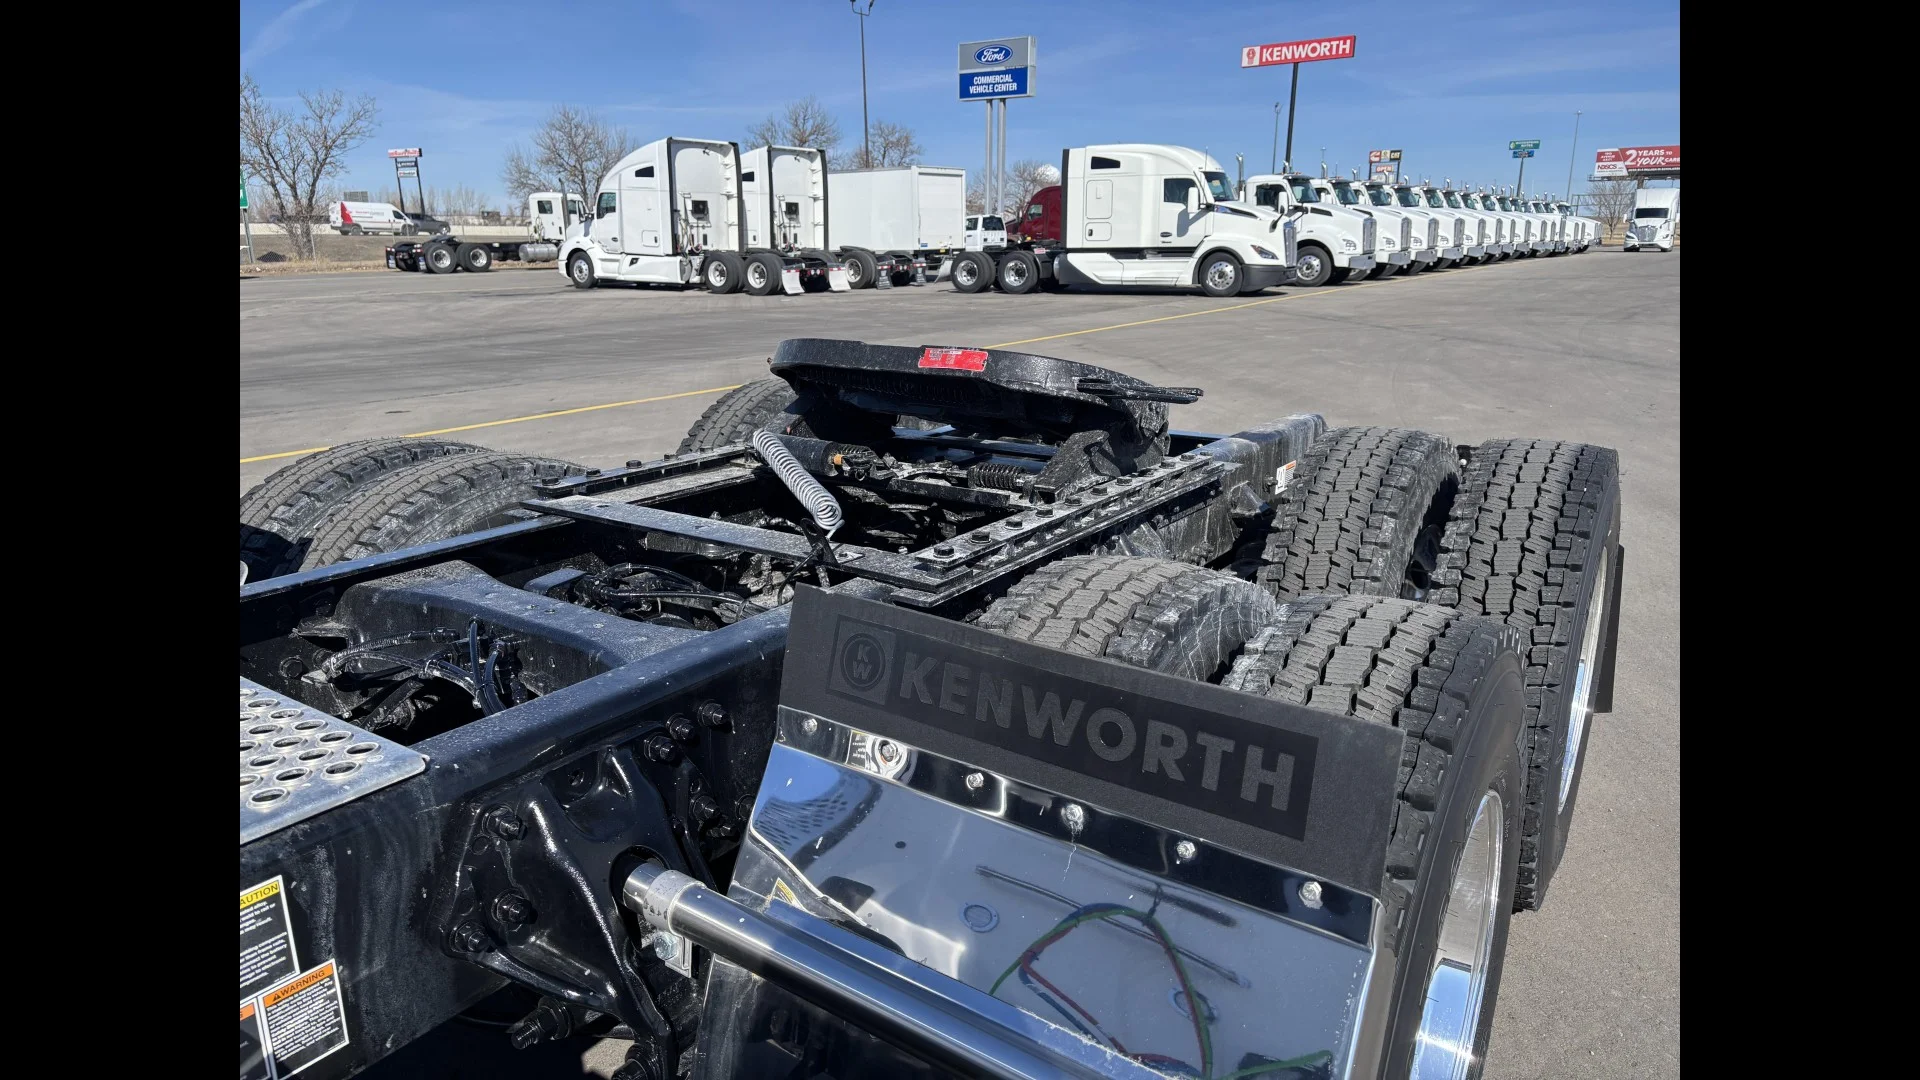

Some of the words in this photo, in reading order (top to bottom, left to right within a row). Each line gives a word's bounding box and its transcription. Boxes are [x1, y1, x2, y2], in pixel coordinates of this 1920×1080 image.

[981, 48, 1006, 62] Ford
[1262, 39, 1351, 62] KENWORTH
[973, 74, 1013, 85] COMMERCIAL
[969, 85, 994, 95] VEHICLE
[994, 82, 1018, 93] CENTER
[1625, 149, 1637, 165] 2
[1638, 149, 1665, 157] YEARS
[1637, 156, 1667, 167] YOUR
[900, 651, 1296, 812] KENWORTH
[281, 970, 325, 997] WARNING
